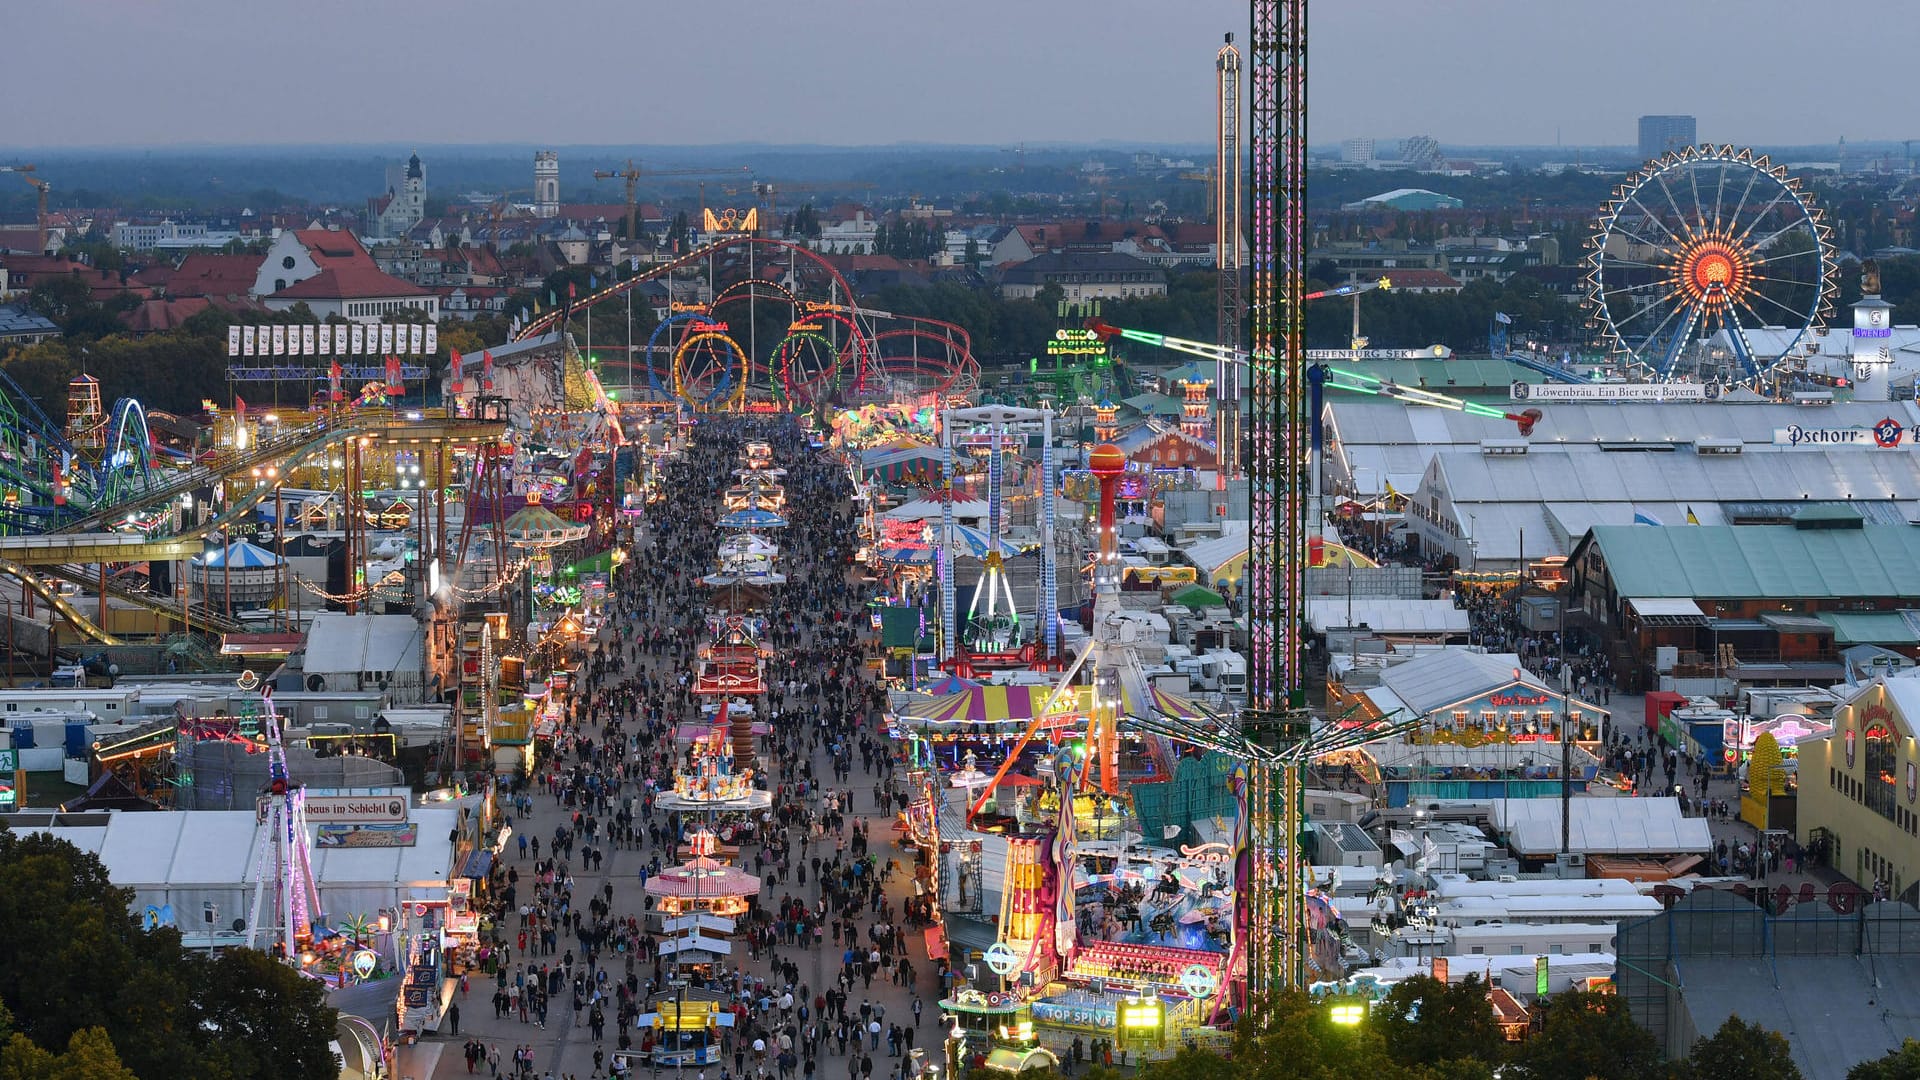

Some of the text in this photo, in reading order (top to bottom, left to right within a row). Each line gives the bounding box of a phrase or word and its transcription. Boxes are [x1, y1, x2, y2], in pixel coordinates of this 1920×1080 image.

[671, 301, 707, 313] Olympia
[1066, 329, 1088, 340] RIO
[1047, 340, 1106, 355] RAPIDOS
[1305, 349, 1417, 358] MPHENBURG SEKT
[1536, 386, 1700, 399] Löwenbräu. Ein Bier wie Bayern.
[333, 804, 346, 816] im
[347, 802, 386, 815] Schichtl
[1048, 1008, 1070, 1020] TOP
